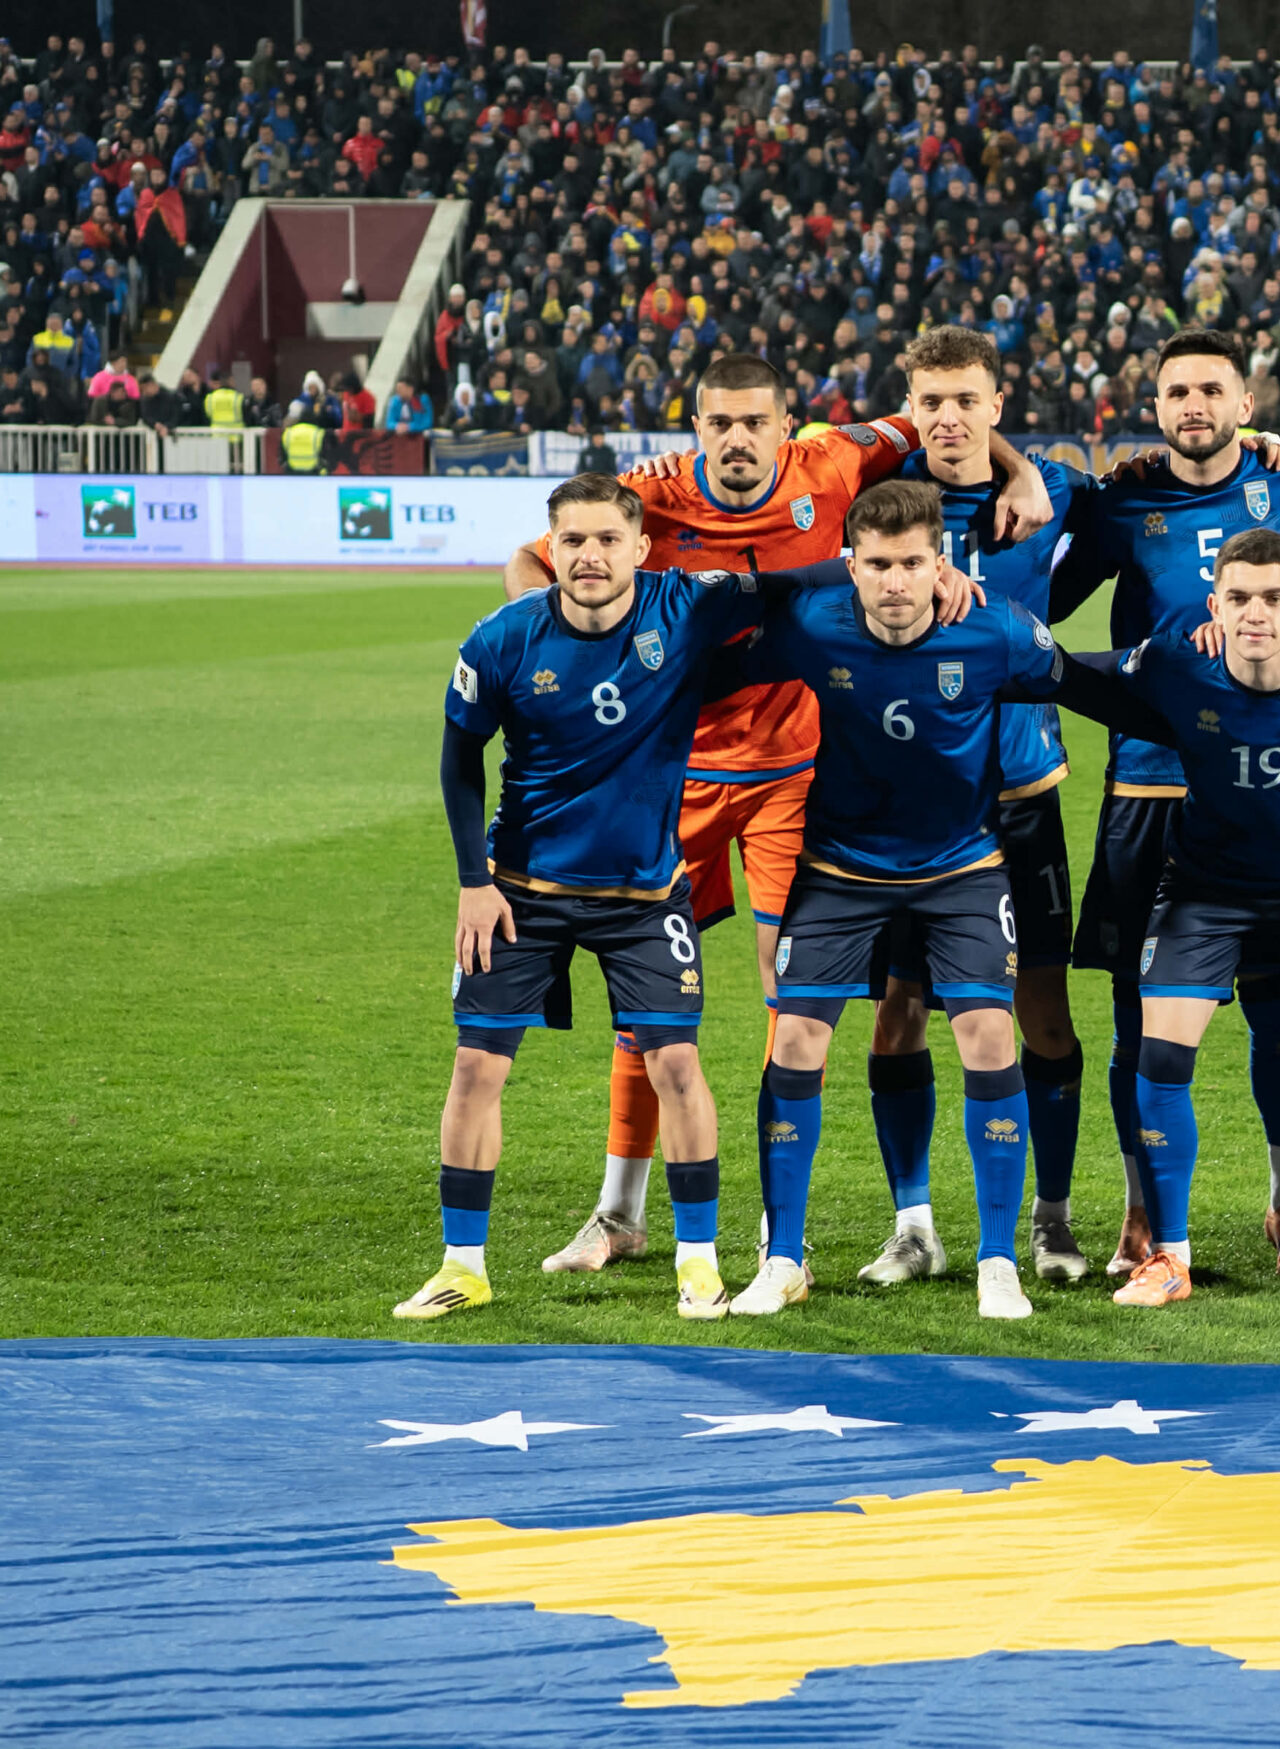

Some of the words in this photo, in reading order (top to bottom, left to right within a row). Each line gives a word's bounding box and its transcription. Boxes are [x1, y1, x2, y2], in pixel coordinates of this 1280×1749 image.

[146, 502, 198, 520] TEB
[401, 504, 455, 522] TEB
[737, 546, 758, 573] 1
[1197, 528, 1223, 582] 5
[592, 682, 627, 725] 8
[883, 699, 915, 741] 6
[663, 914, 695, 964] 8
[998, 893, 1017, 945] 6
